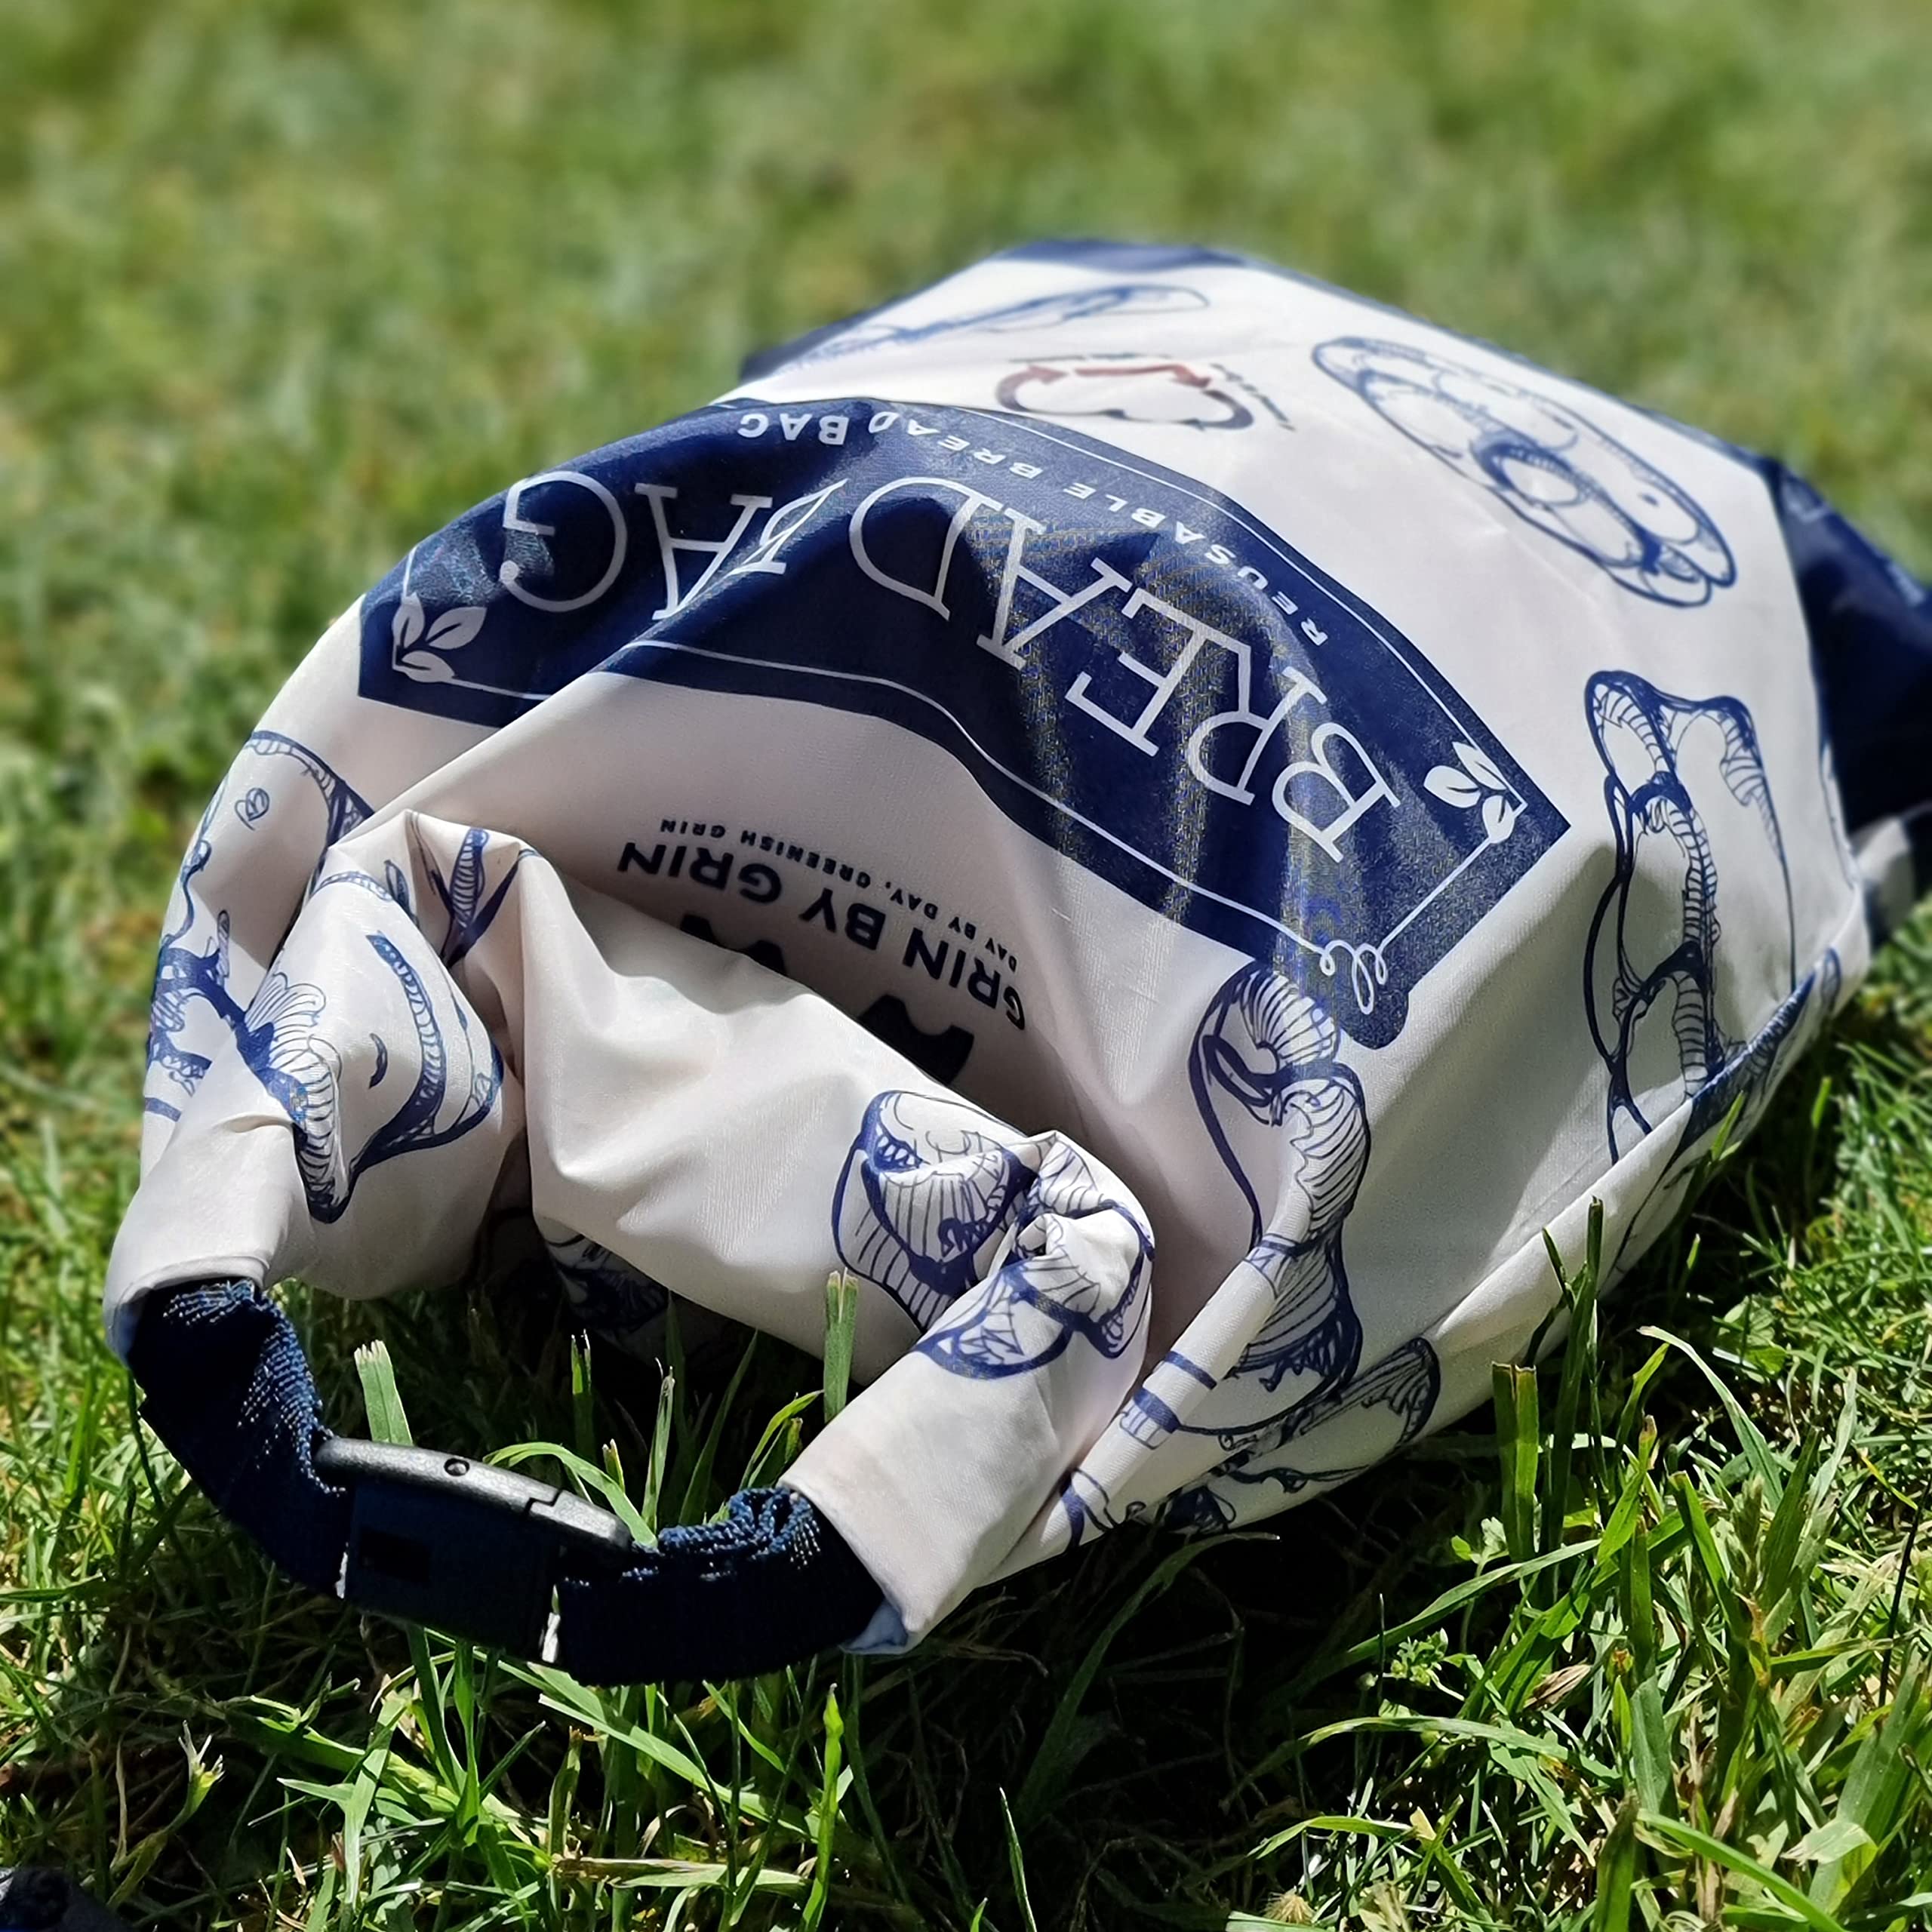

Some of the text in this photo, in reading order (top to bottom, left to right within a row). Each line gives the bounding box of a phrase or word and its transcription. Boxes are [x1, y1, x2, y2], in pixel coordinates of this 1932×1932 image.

[737, 411, 1331, 646] REUSABLE BREAD BAG
[848, 475, 1401, 864] BREAD
[617, 841, 782, 904] GRIN
[660, 818, 1017, 974] DAY BY DAY, GREENISH GRIN
[798, 886, 888, 952] BY
[903, 926, 1026, 1031] GRIN
